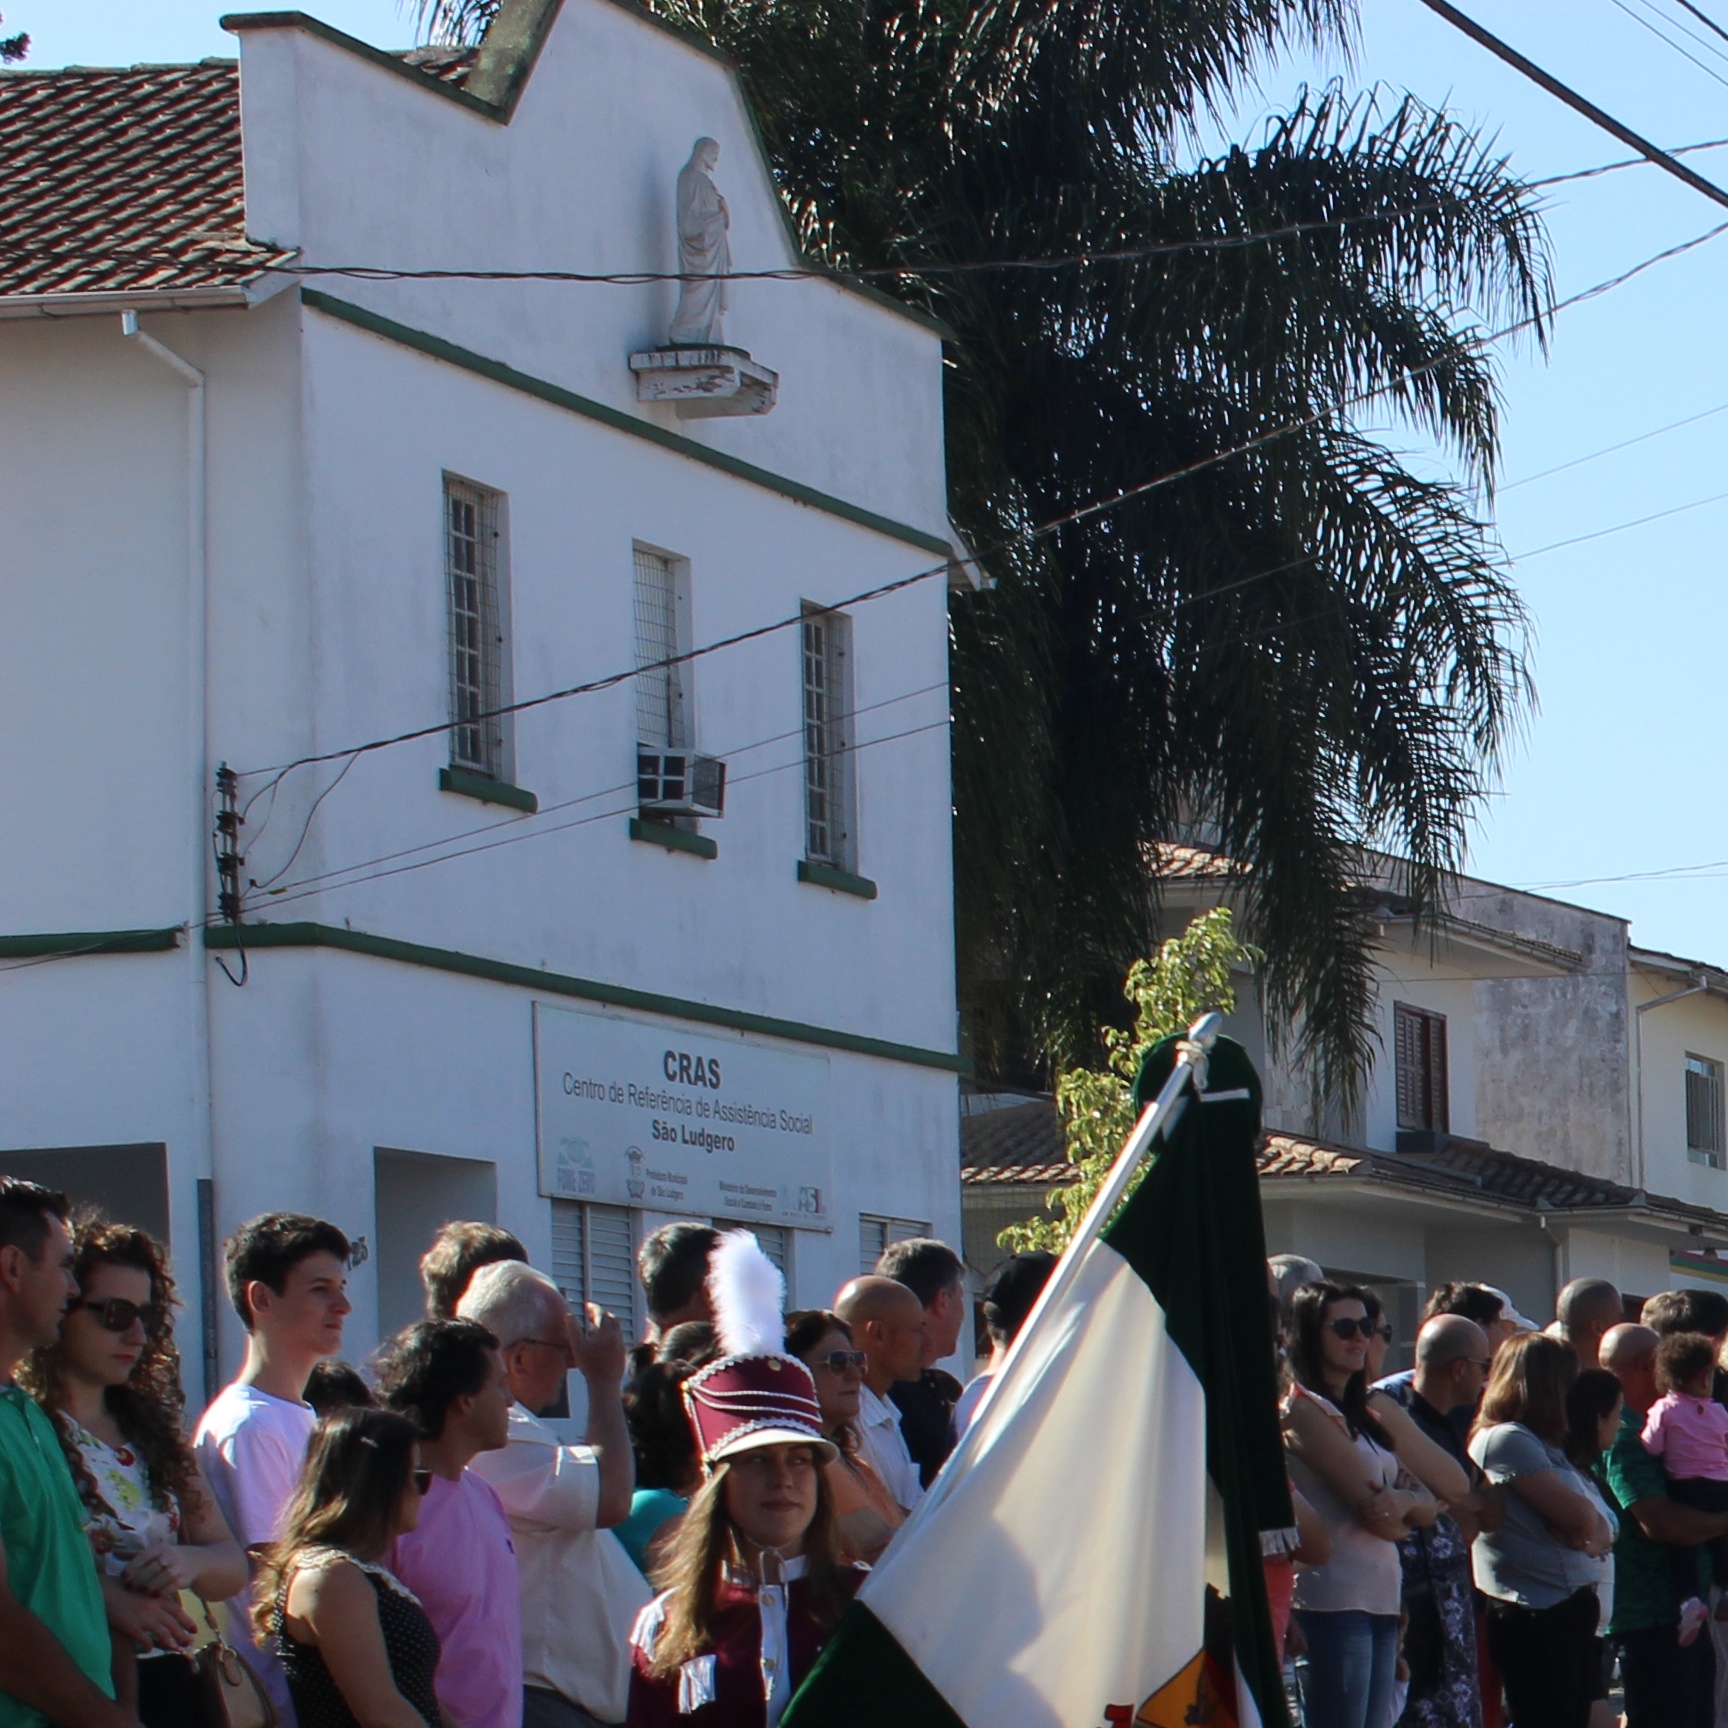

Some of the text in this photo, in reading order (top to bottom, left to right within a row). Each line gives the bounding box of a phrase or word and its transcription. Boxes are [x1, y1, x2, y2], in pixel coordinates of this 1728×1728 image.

[664, 1050, 721, 1089] CRAS
[563, 1072, 813, 1135] Centro de Referência de Assistência Social
[652, 1119, 735, 1153] São Ludgero
